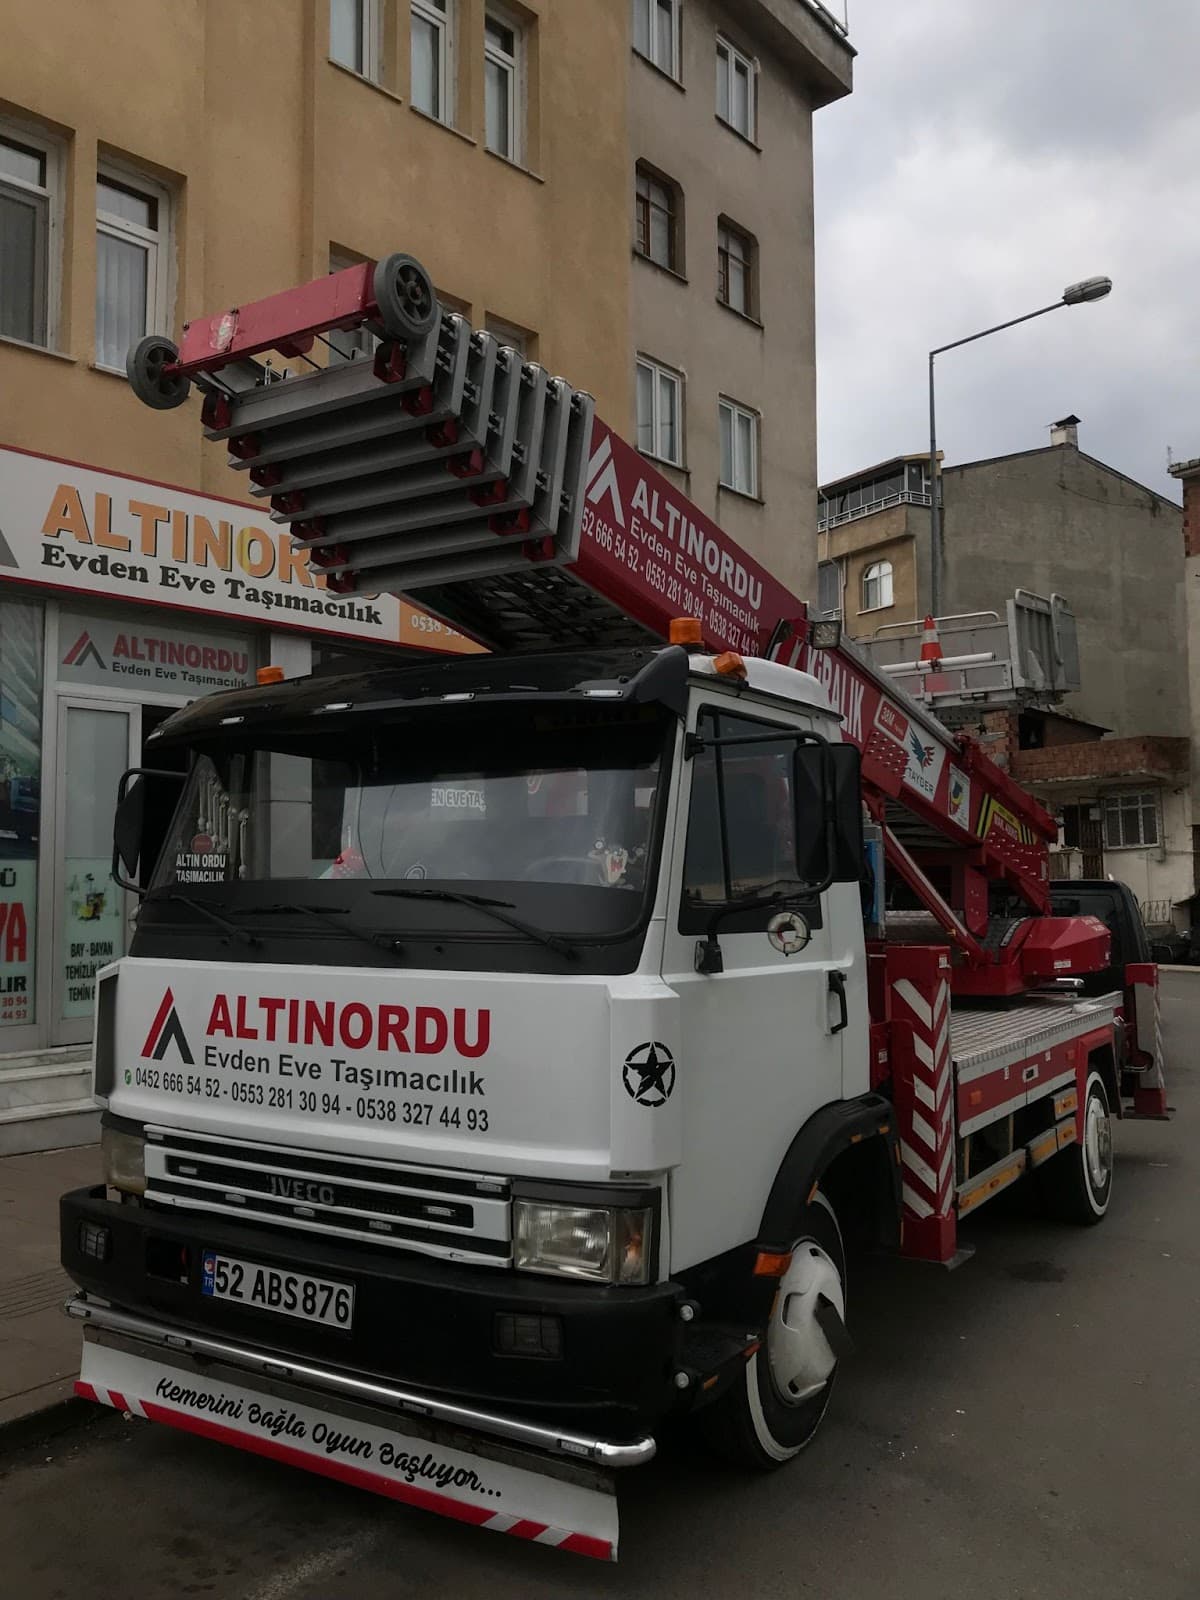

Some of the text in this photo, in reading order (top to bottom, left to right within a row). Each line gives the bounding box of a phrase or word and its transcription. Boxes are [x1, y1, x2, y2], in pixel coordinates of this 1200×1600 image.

[41, 484, 380, 600] ALTINOR
[630, 478, 762, 610] ALTINORDU
[41, 543, 382, 625] Evden Eve Taşımacılık
[595, 518, 613, 552] 666
[614, 534, 626, 562] 54
[627, 544, 639, 573] 52
[645, 559, 666, 593] 0553
[667, 575, 681, 605] 281
[683, 588, 693, 614] 30
[693, 597, 704, 622] 94
[709, 608, 727, 640] 0538
[728, 622, 740, 648] 327
[630, 516, 760, 634] Evden Eve Taşımacılık
[112, 662, 248, 689] Evden Eve Taşımacılık
[113, 633, 248, 675] ALTINORDU
[176, 853, 226, 868] ALTIN ORDU
[66, 961, 97, 980] TEMİZLİK
[71, 943, 85, 958] BAY
[90, 941, 113, 957] BAYAN
[68, 984, 90, 1001] TEMİN
[206, 994, 491, 1058] ALTINORDU
[204, 1045, 485, 1096] Evden Eve Taşımacılık
[136, 1067, 160, 1089] 0452
[163, 1072, 183, 1092] 666
[187, 1075, 201, 1095] 54
[205, 1078, 220, 1098] 52
[231, 1082, 264, 1105] 0553
[268, 1087, 293, 1109] 281
[299, 1090, 316, 1111] 30
[322, 1093, 341, 1115] 94
[356, 1097, 396, 1122] 0538
[402, 1102, 433, 1126] 327
[439, 1106, 461, 1129] 44
[467, 1108, 489, 1132] 93
[269, 1175, 335, 1205] IVECO
[215, 1260, 244, 1298] 52
[156, 1377, 244, 1419] Kemerini
[248, 1403, 306, 1438] Bağla
[312, 1423, 373, 1459] Oyun
